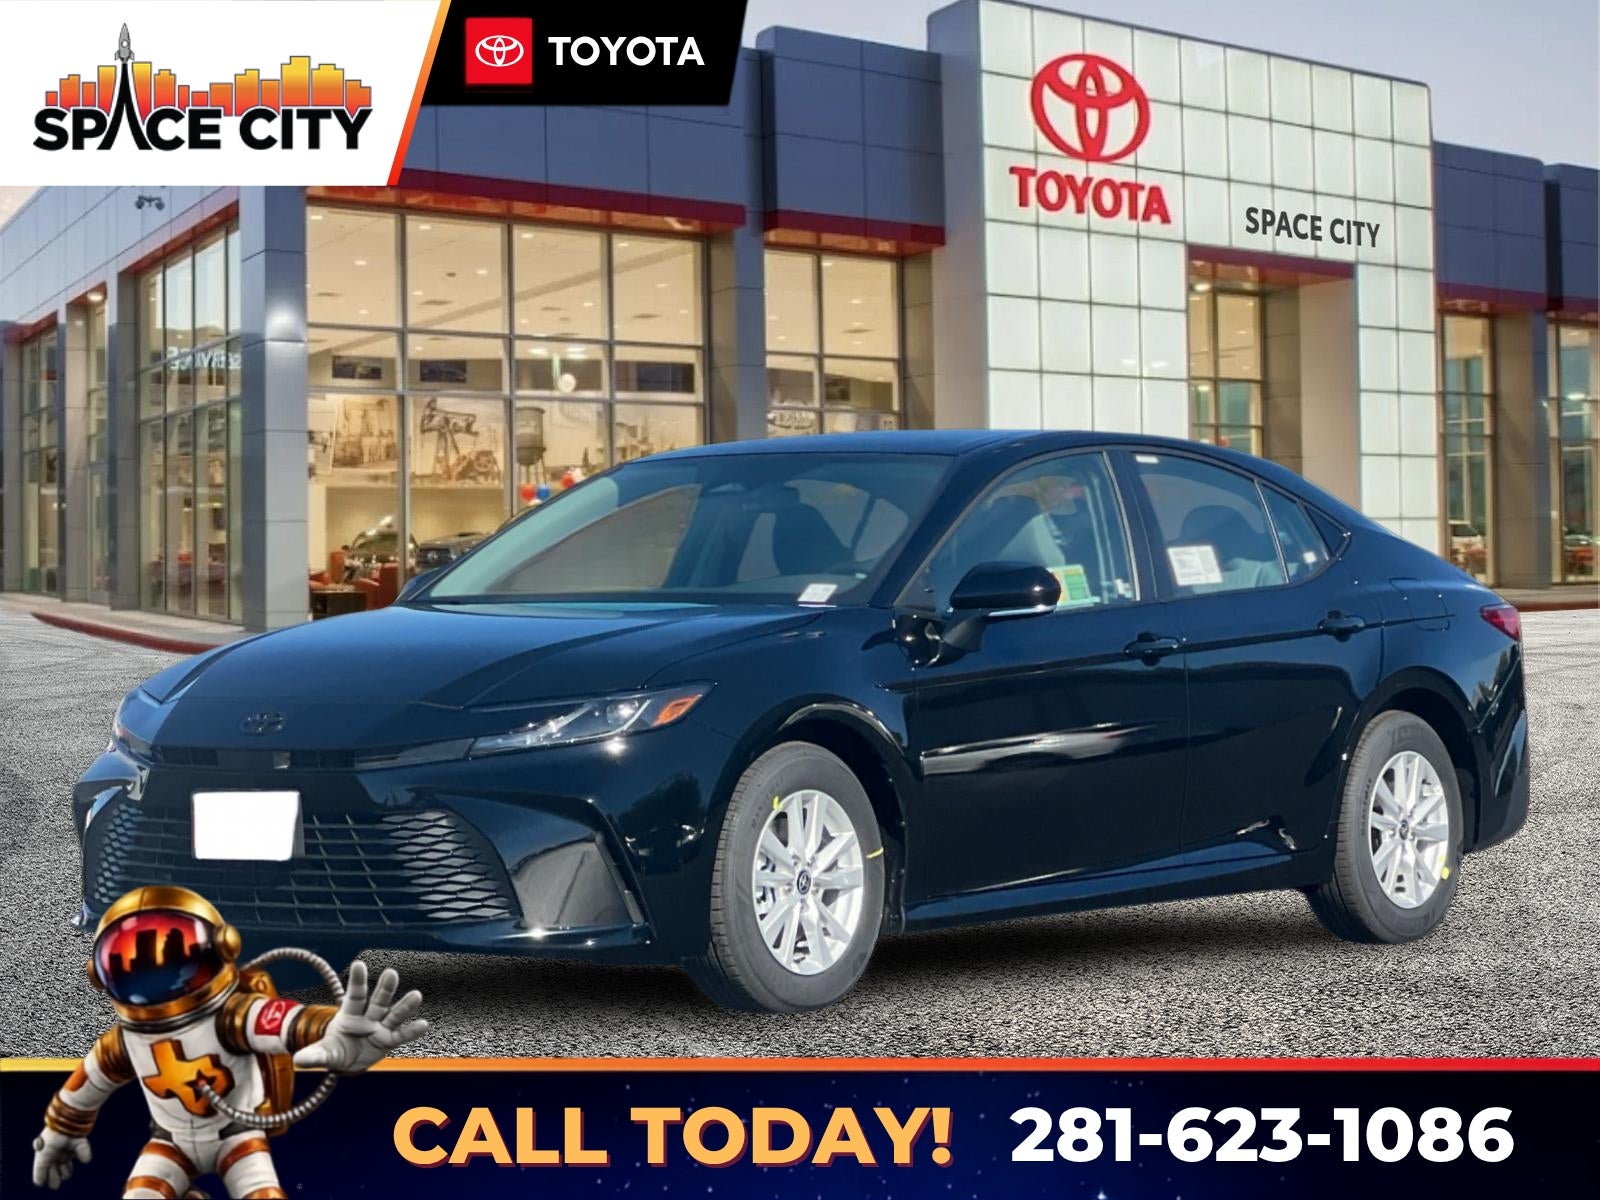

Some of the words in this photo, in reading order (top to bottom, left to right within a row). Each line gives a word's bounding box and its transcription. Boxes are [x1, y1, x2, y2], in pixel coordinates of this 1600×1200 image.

[1009, 166, 1171, 224] TOYOTA
[1245, 206, 1323, 242] SPACE
[1329, 217, 1381, 248] CITY
